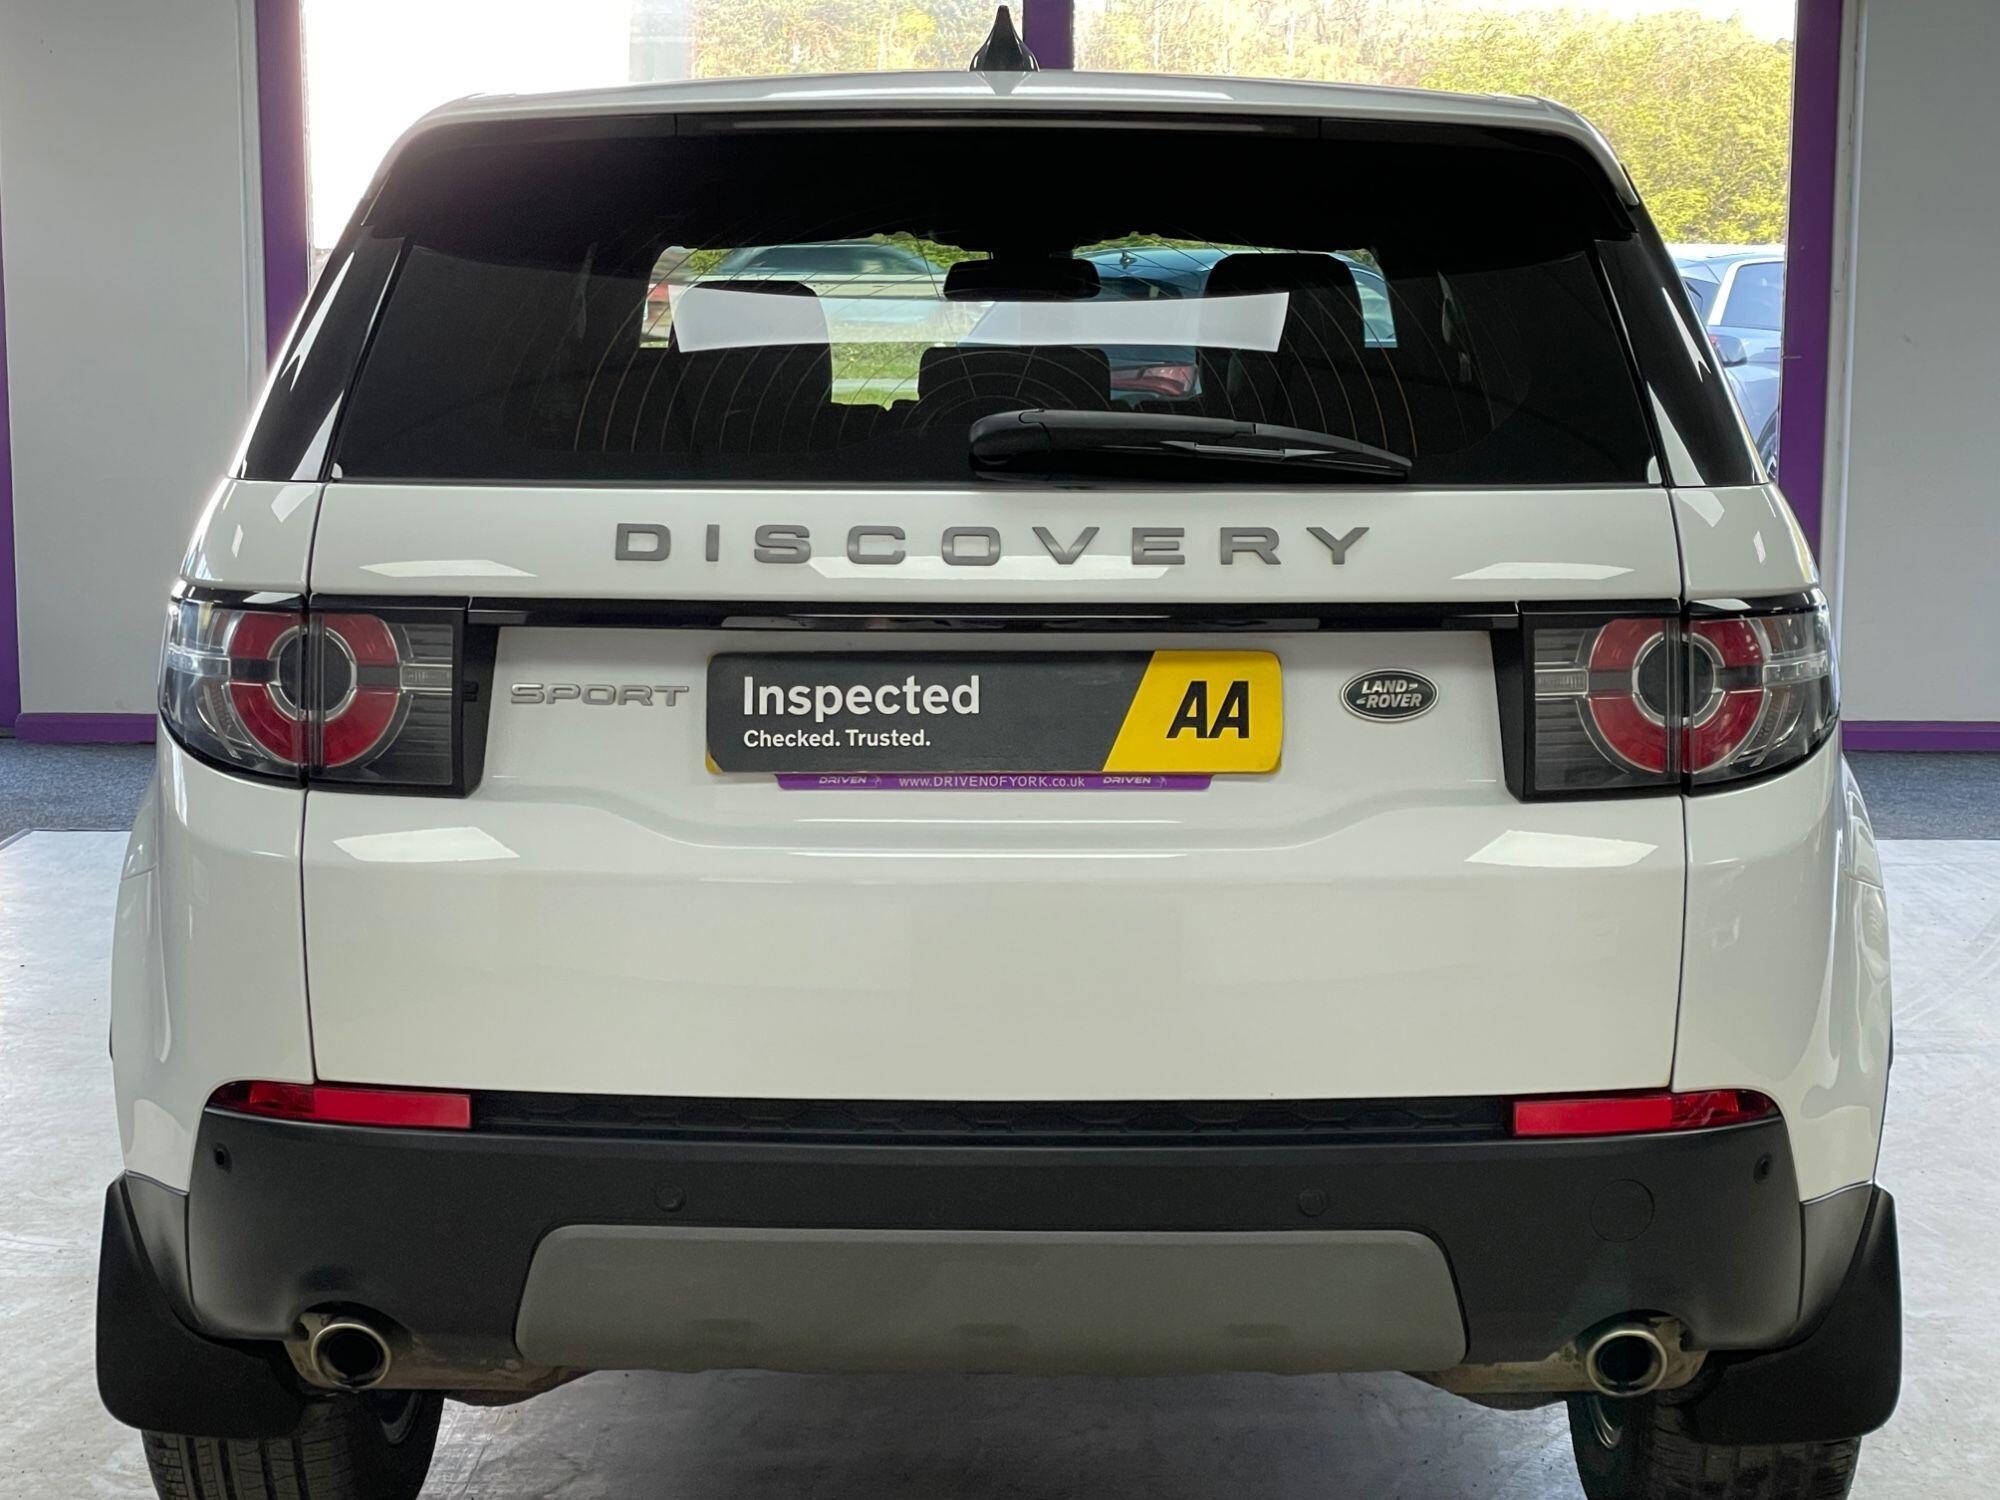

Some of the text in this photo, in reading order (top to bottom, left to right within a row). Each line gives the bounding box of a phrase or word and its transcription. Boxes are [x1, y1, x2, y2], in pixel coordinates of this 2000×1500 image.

[614, 522, 1370, 566] DISCOVERY
[510, 682, 690, 707] SPORT
[743, 673, 980, 722] Inspected
[1361, 680, 1407, 694] LAND
[1166, 680, 1250, 739] AA
[1366, 693, 1422, 708] ROVER
[743, 729, 931, 747] Checked. Trusted.
[818, 775, 1152, 789] DRIVEN www.DRIVENOFYORK.co.uk DRIVEN
